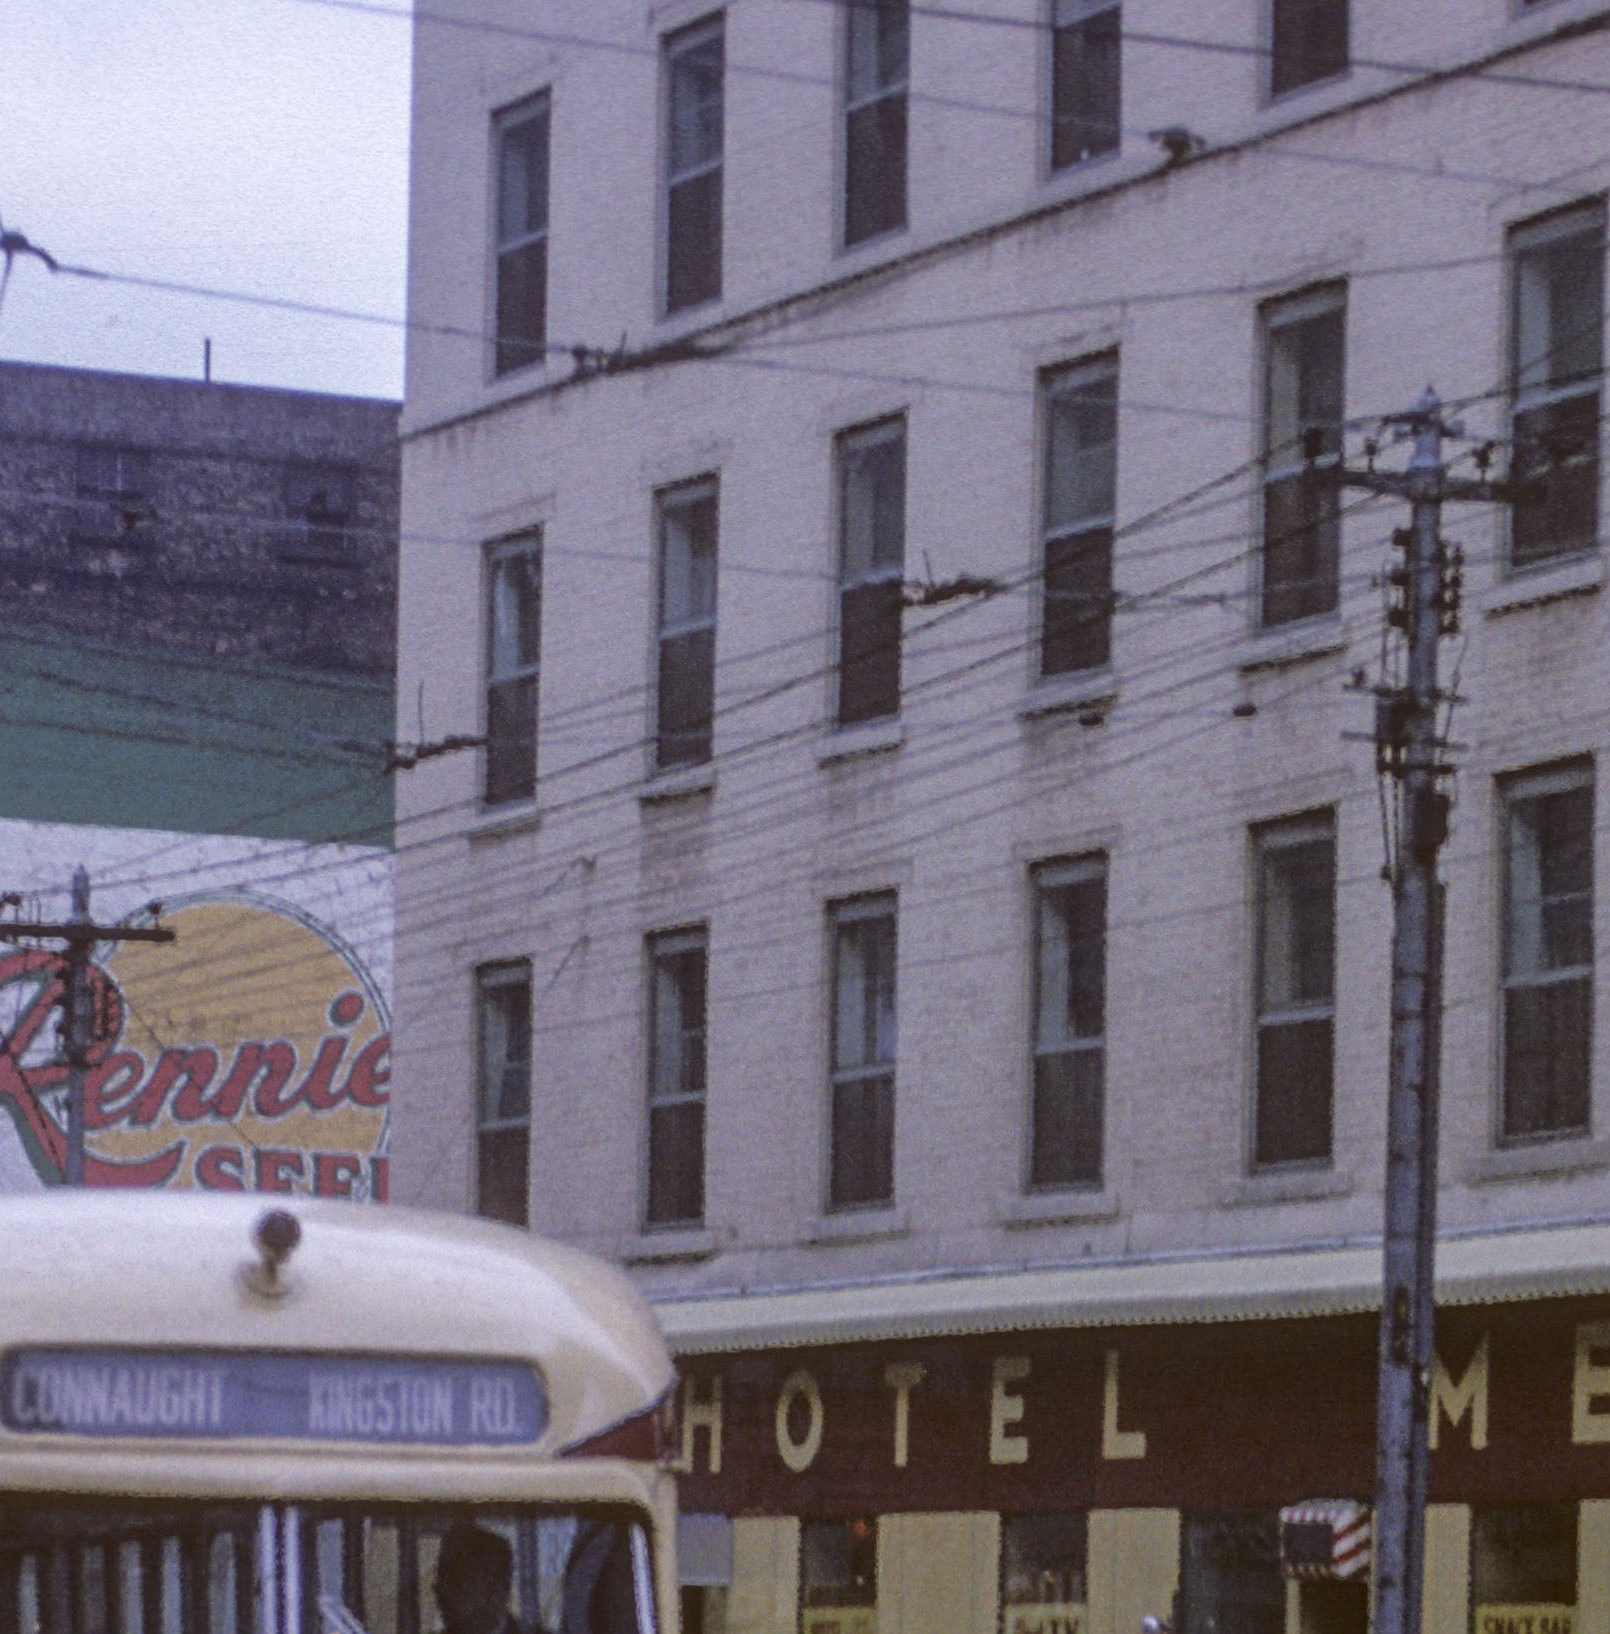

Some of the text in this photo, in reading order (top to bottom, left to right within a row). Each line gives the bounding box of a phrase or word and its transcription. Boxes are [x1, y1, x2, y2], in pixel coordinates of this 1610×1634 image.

[9, 1365, 227, 1427] CONNAUGHT
[307, 1373, 454, 1435] KINGSTON
[682, 1350, 1148, 1474] HOTEL
